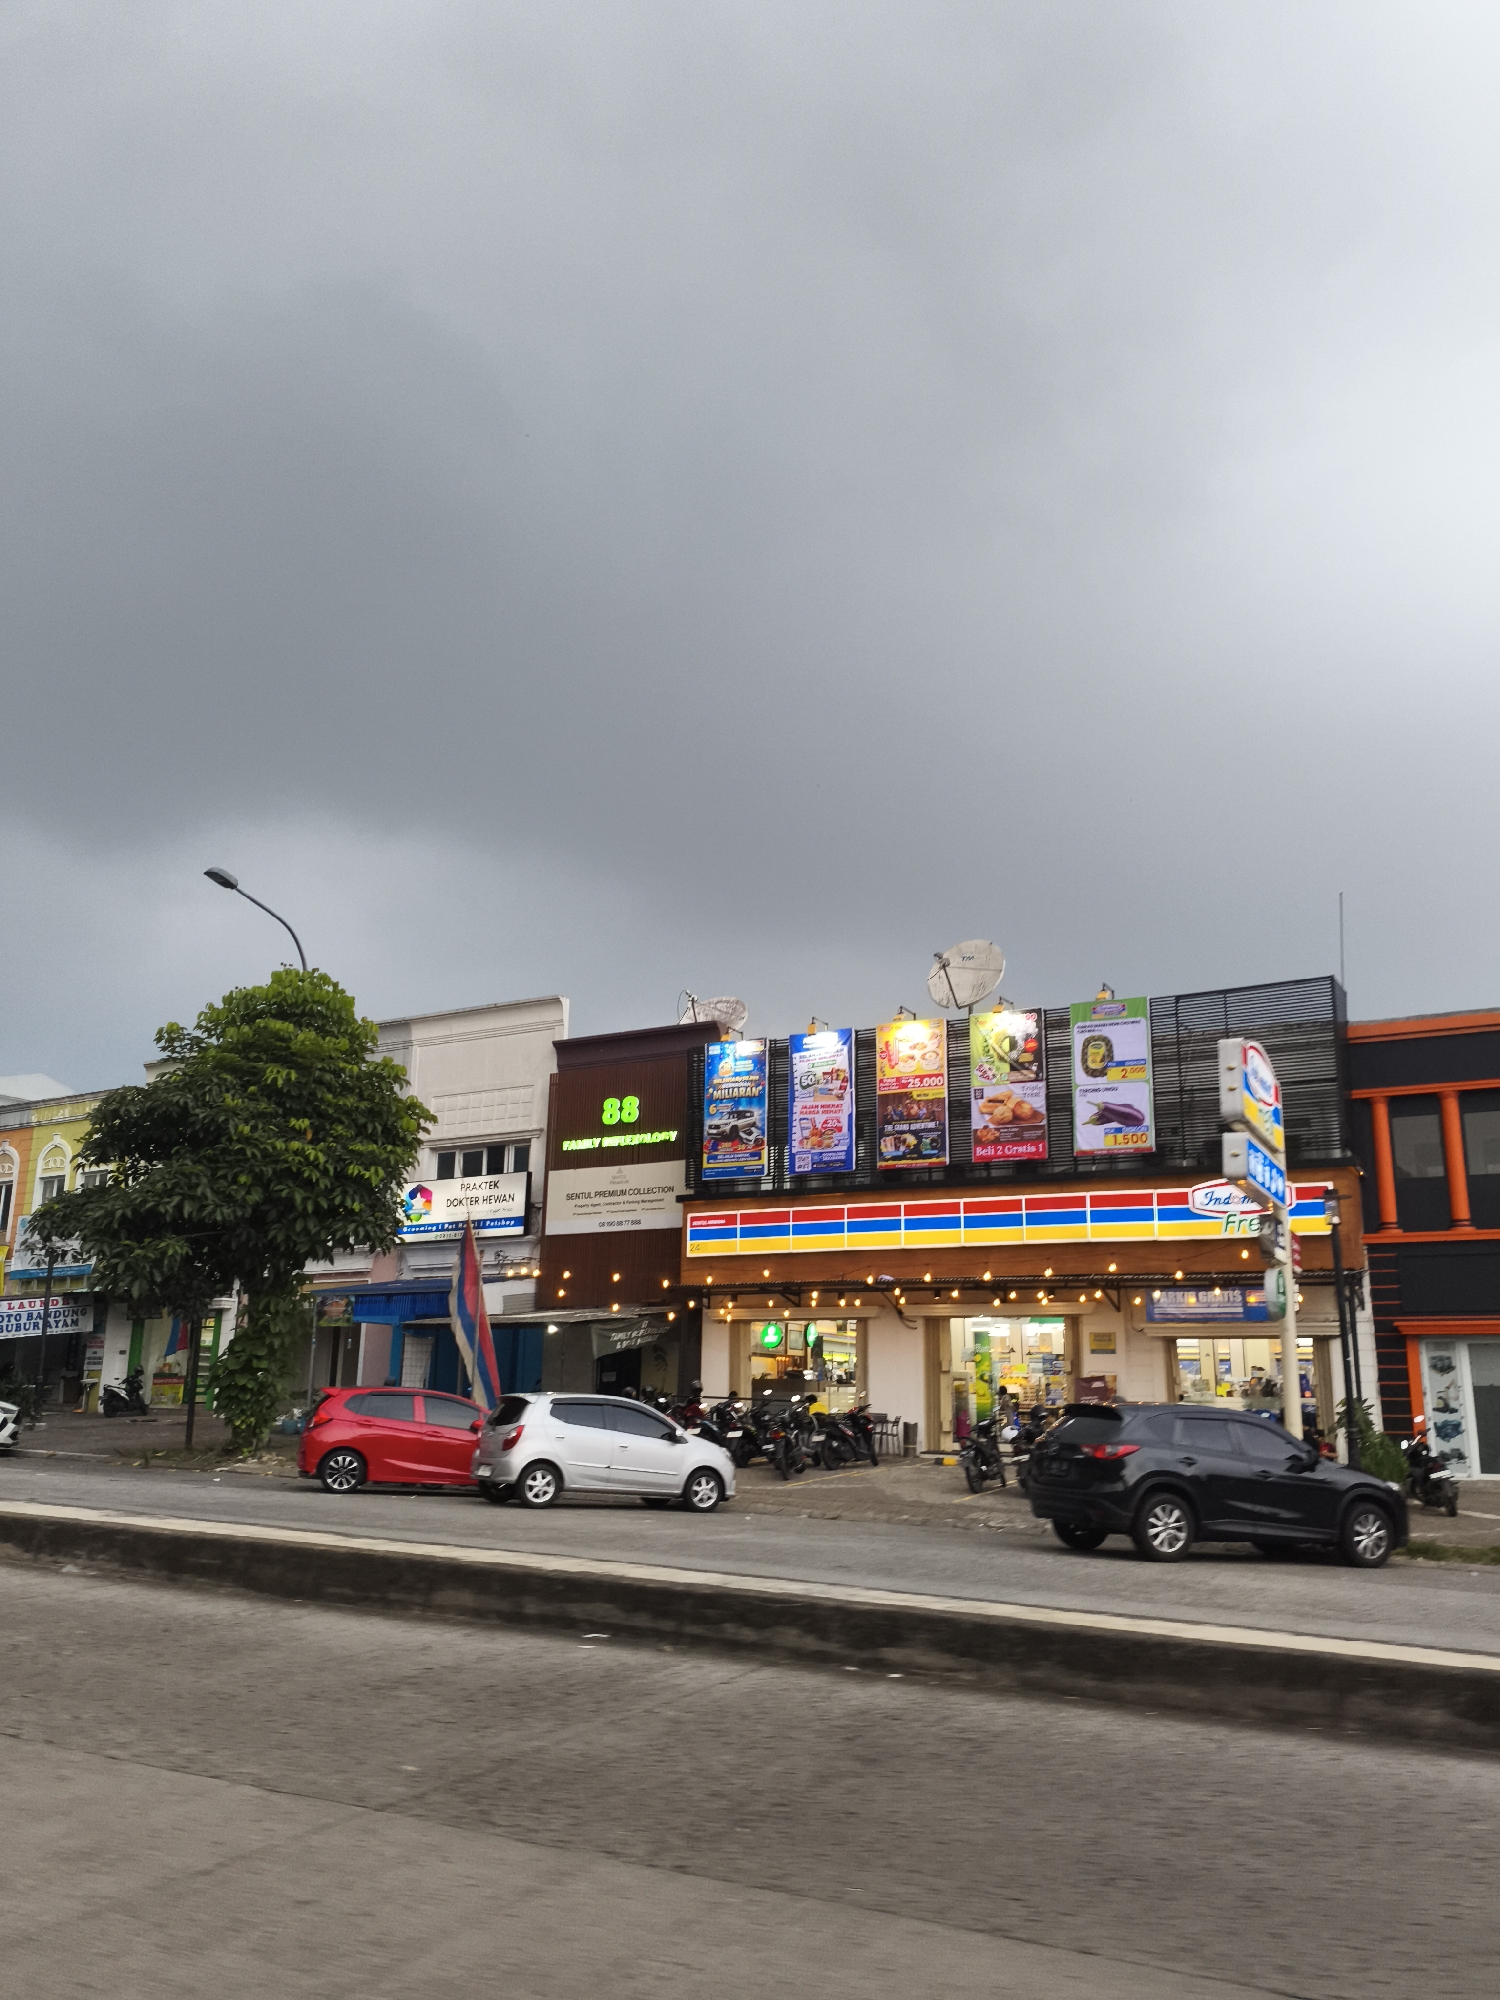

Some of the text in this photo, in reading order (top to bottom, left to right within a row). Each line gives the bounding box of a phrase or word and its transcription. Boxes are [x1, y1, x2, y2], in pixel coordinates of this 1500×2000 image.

[801, 1075, 815, 1086] 50
[907, 1076, 943, 1088] 25.000
[712, 1087, 759, 1100] MILIARAN
[602, 1096, 640, 1125] 88
[709, 1104, 717, 1115] 6
[884, 1124, 895, 1132] THE
[562, 1137, 602, 1151] FAMILY
[1113, 1133, 1148, 1146] 1.500
[975, 1143, 1043, 1157] Beli 2 Gratis 1
[460, 1180, 500, 1192] PRAKTEK
[566, 1186, 674, 1201] SENTUL PREMIUM COLLECTION
[446, 1193, 515, 1208] DOKTER HEWAN
[402, 1225, 436, 1233] Grooming
[458, 1221, 478, 1229] Hoel
[46, 1317, 79, 1329] AYAM
